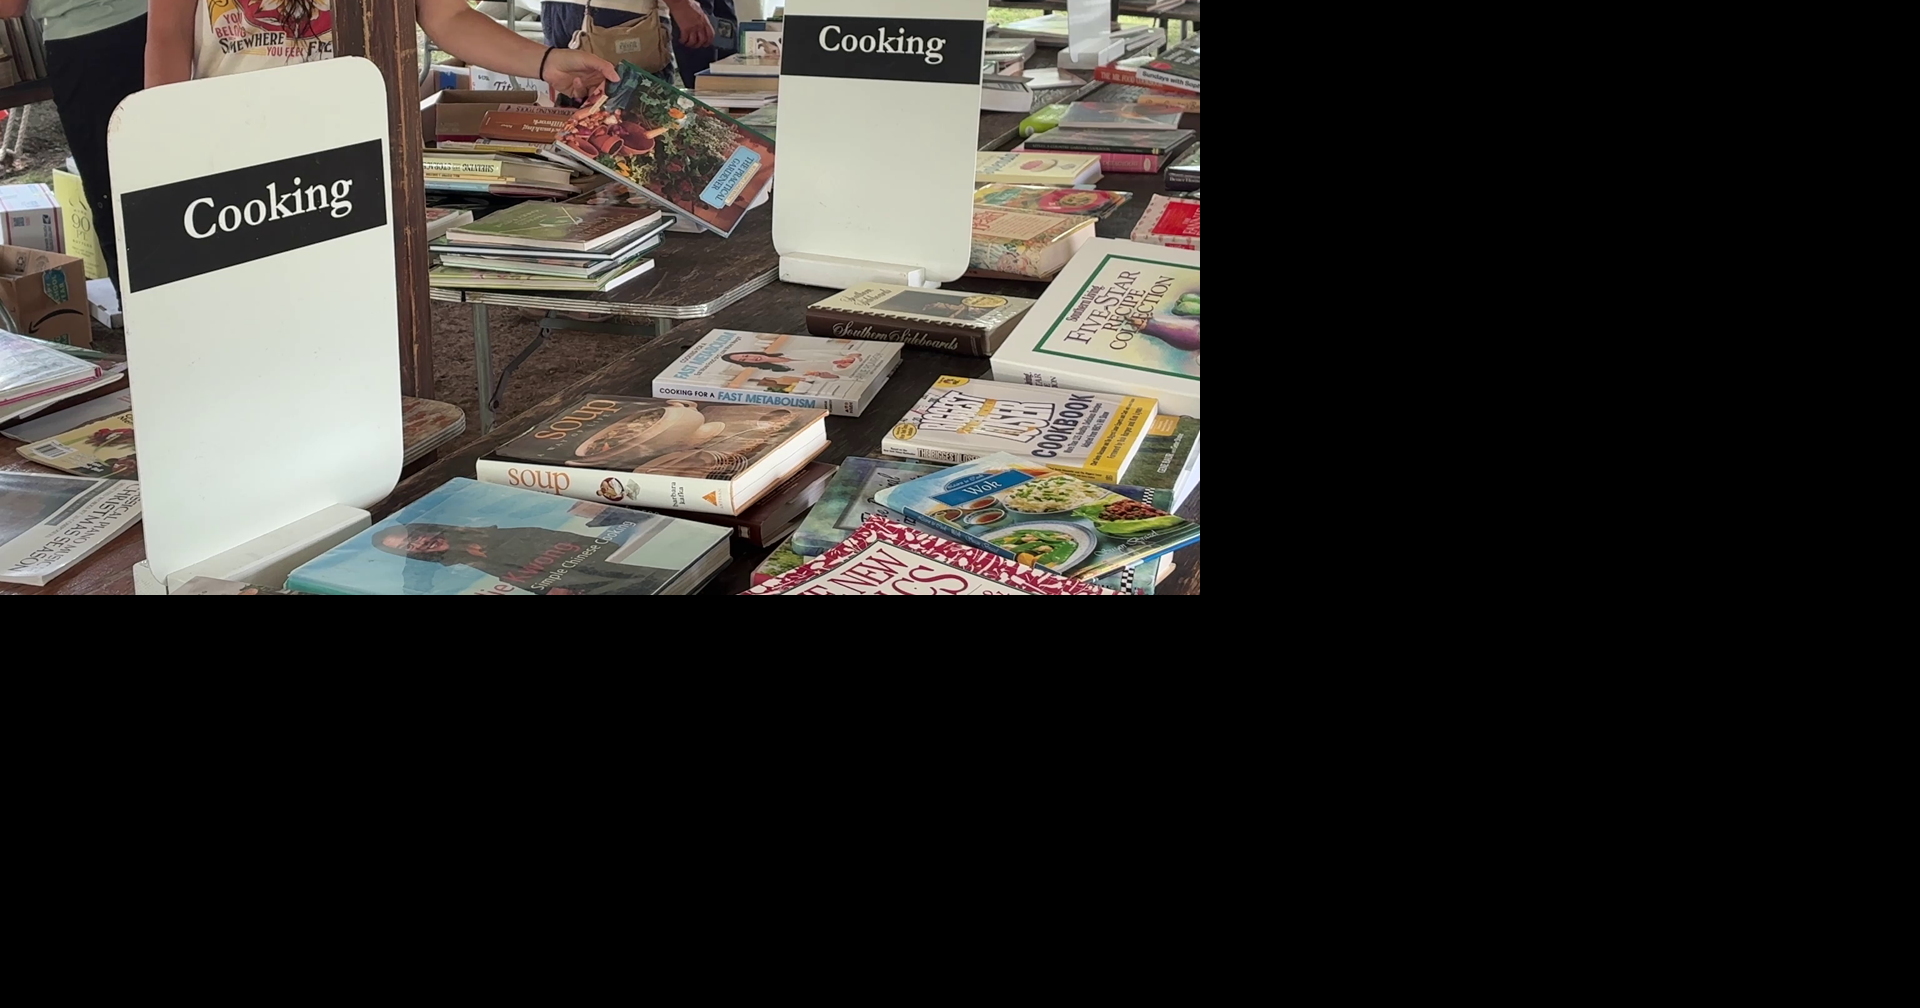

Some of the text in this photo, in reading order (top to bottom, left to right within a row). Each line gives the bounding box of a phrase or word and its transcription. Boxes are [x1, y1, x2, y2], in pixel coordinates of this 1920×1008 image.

[223, 12, 243, 24] YOU
[267, 46, 283, 56] YOU
[818, 25, 946, 65] Cooking
[1142, 70, 1170, 82] Sundays
[1170, 77, 1184, 86] with
[711, 158, 740, 191] GARDENER
[715, 167, 745, 201] PRACTICAL
[71, 213, 91, 232] 90
[183, 177, 353, 239] Cooking
[1101, 289, 1145, 332] RECIPE
[1109, 275, 1175, 350] COLLECTION
[832, 321, 959, 351] Southern Sideboards
[673, 364, 698, 379] FAST
[689, 332, 737, 366] METABOLISM
[659, 387, 693, 396] COOKING
[718, 391, 743, 402] FAST
[745, 394, 816, 409] METABOLISM
[534, 399, 623, 440] soup
[1031, 393, 1095, 458] COOKBOOK
[917, 448, 930, 458] THE
[930, 451, 958, 462] BIGGEST
[960, 454, 980, 462] LOSE
[507, 467, 571, 496] soup
[679, 486, 687, 506] kafka
[964, 480, 1003, 496] Wok
[63, 484, 140, 537] CHRISTMAS
[72, 521, 110, 545] PIANO
[8, 536, 71, 572] SEASON
[36, 543, 77, 567] MUSIC
[502, 541, 582, 583] Kwong
[530, 519, 637, 591] Simple Chinese Cooking
[827, 548, 909, 595] NEW
